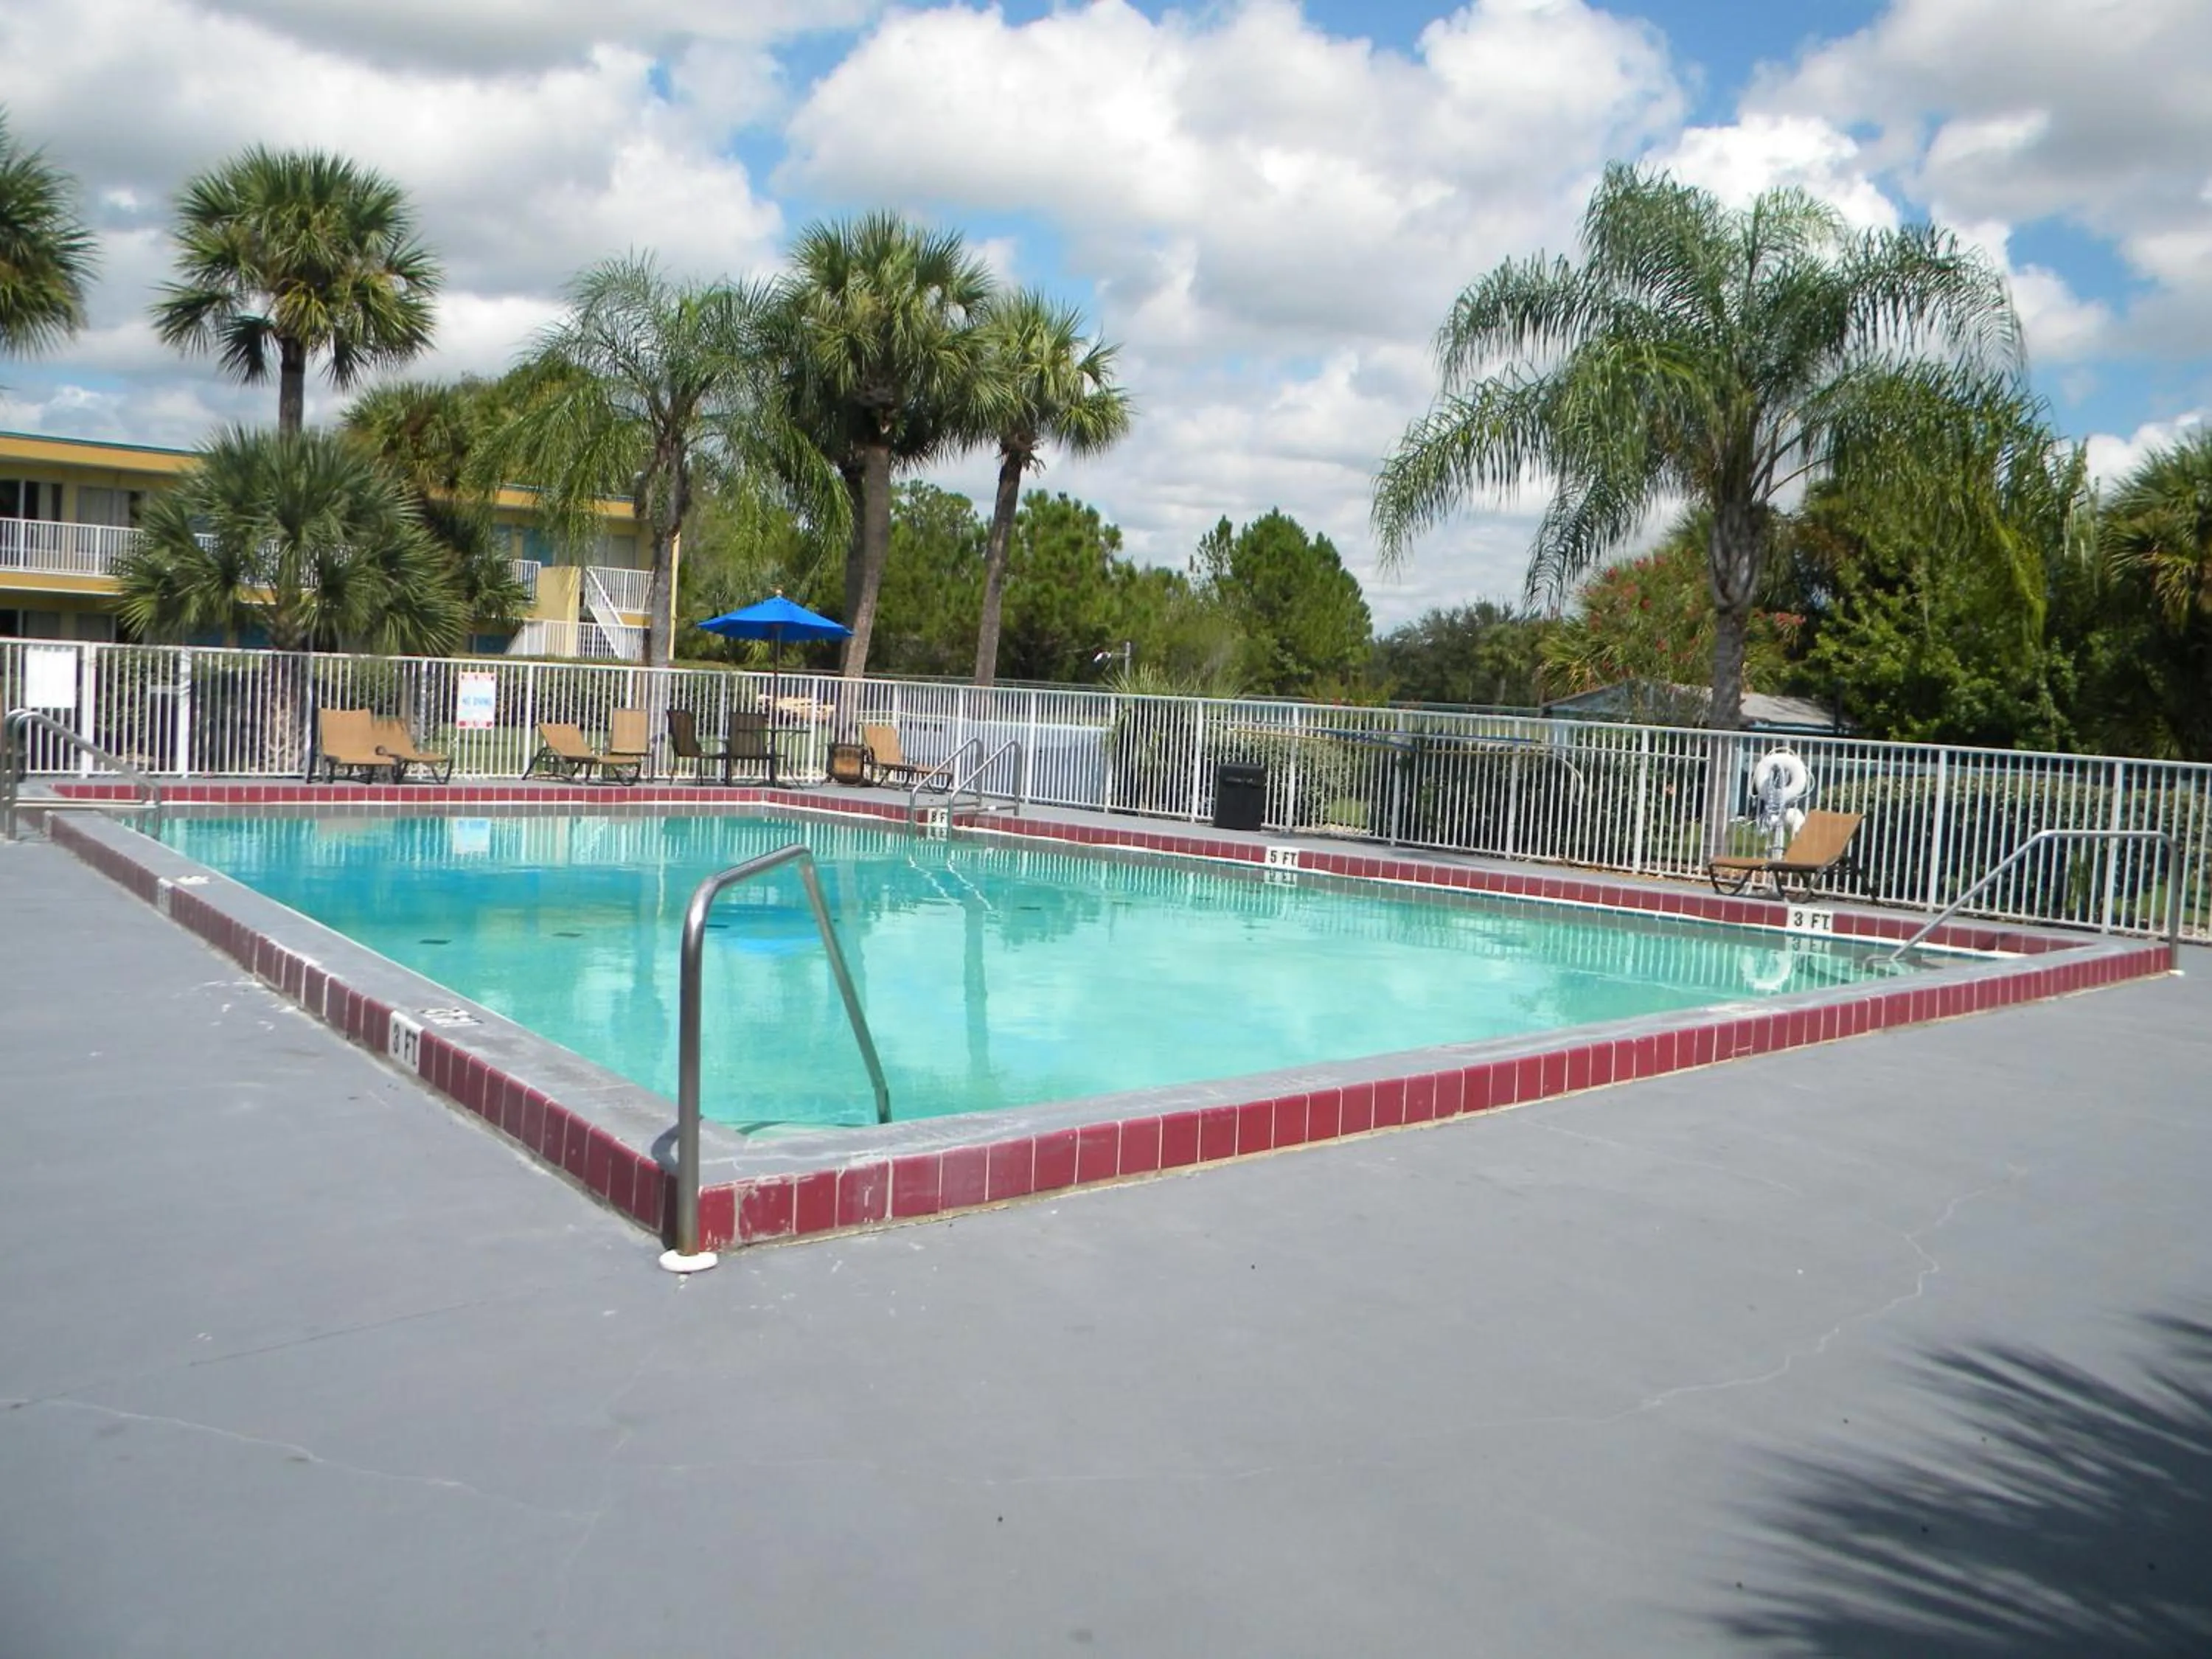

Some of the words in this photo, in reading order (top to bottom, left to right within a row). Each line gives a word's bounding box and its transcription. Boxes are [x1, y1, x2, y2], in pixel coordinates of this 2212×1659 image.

[1270, 850, 1277, 863] 5
[1794, 911, 1803, 927] 3
[394, 1022, 400, 1054] 3
